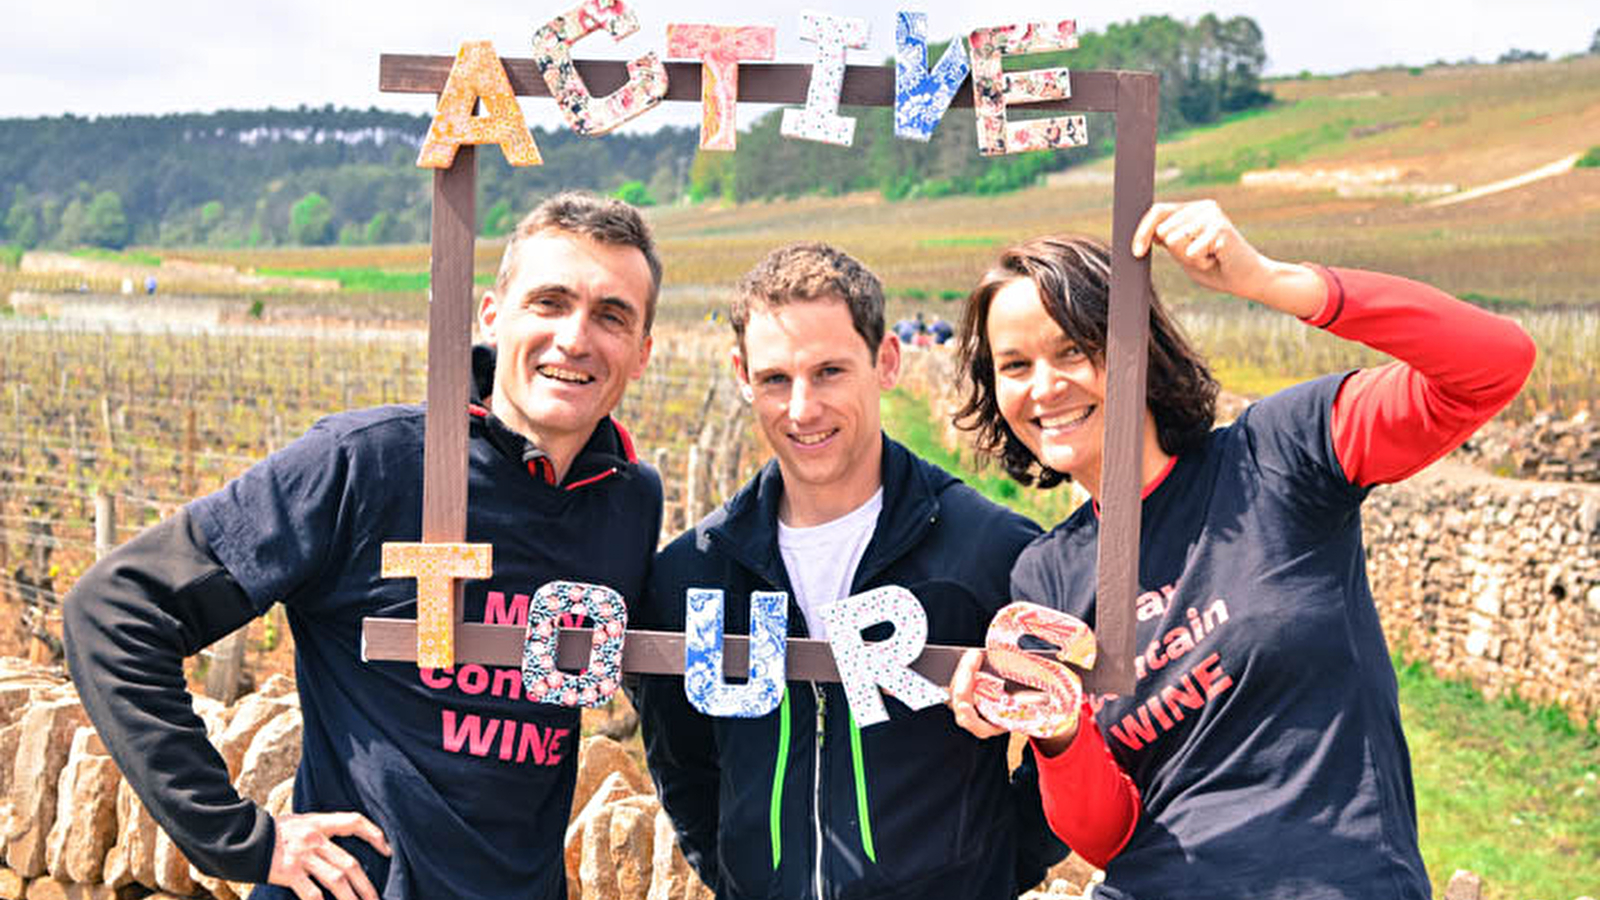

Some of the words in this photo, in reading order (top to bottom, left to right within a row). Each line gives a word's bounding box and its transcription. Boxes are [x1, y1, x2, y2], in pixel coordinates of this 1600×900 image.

[416, 0, 1088, 169] ACTIVE
[381, 542, 1097, 738] TOURS
[1110, 653, 1233, 751] WINE
[441, 709, 570, 766] WINE
